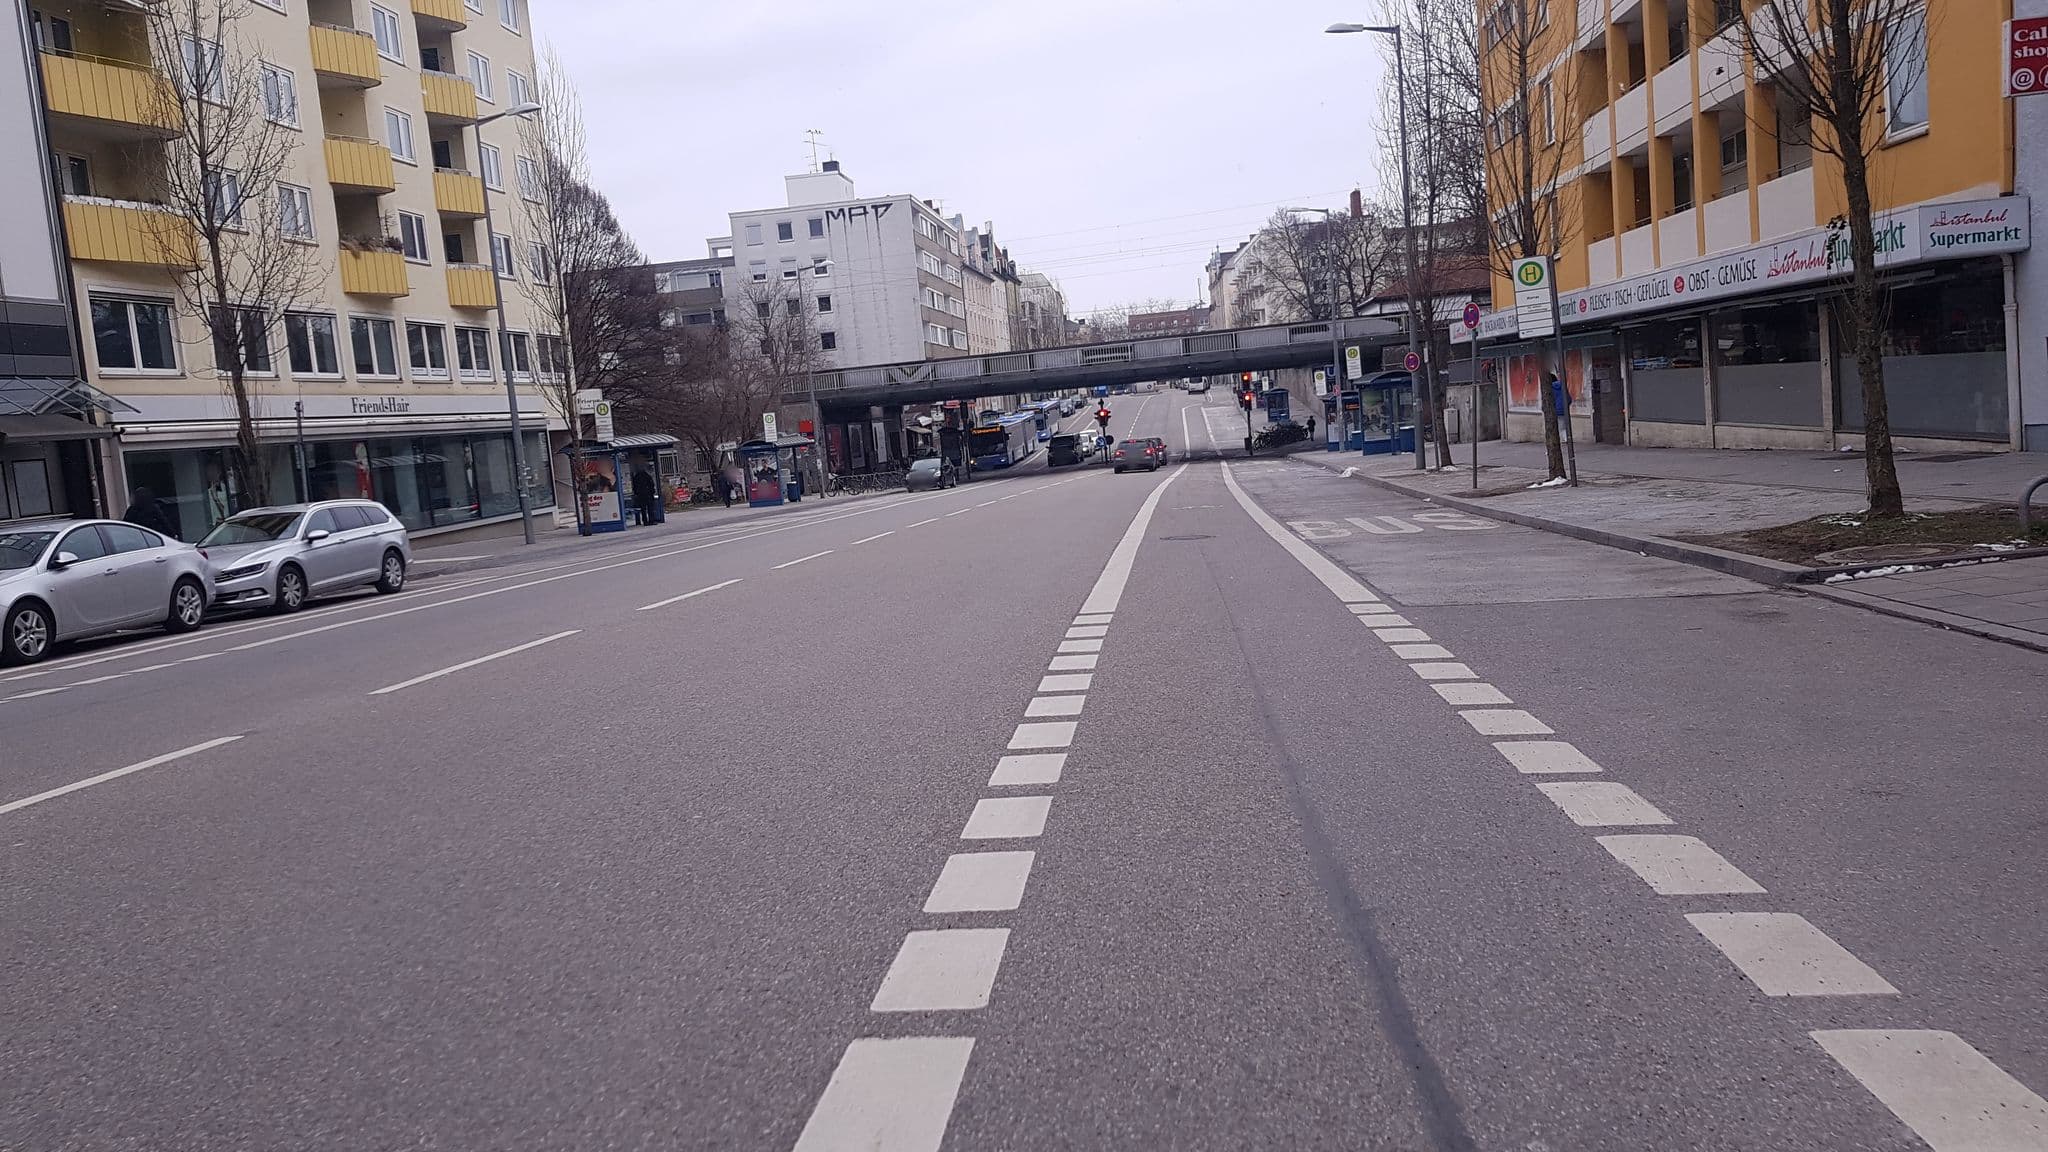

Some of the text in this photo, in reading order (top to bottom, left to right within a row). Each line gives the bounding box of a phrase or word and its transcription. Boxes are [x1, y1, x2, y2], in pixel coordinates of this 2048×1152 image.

[2013, 46, 2048, 60] sho
[1930, 226, 2022, 248] Supermarkt
[1589, 292, 1611, 311] FLEISCH
[1615, 287, 1633, 306] FISCH
[1637, 278, 1671, 302] GEFLÜGEL
[1688, 268, 1710, 292] OBST
[1717, 257, 1758, 286] GEMÜSE
[1286, 510, 1500, 540] BUS
